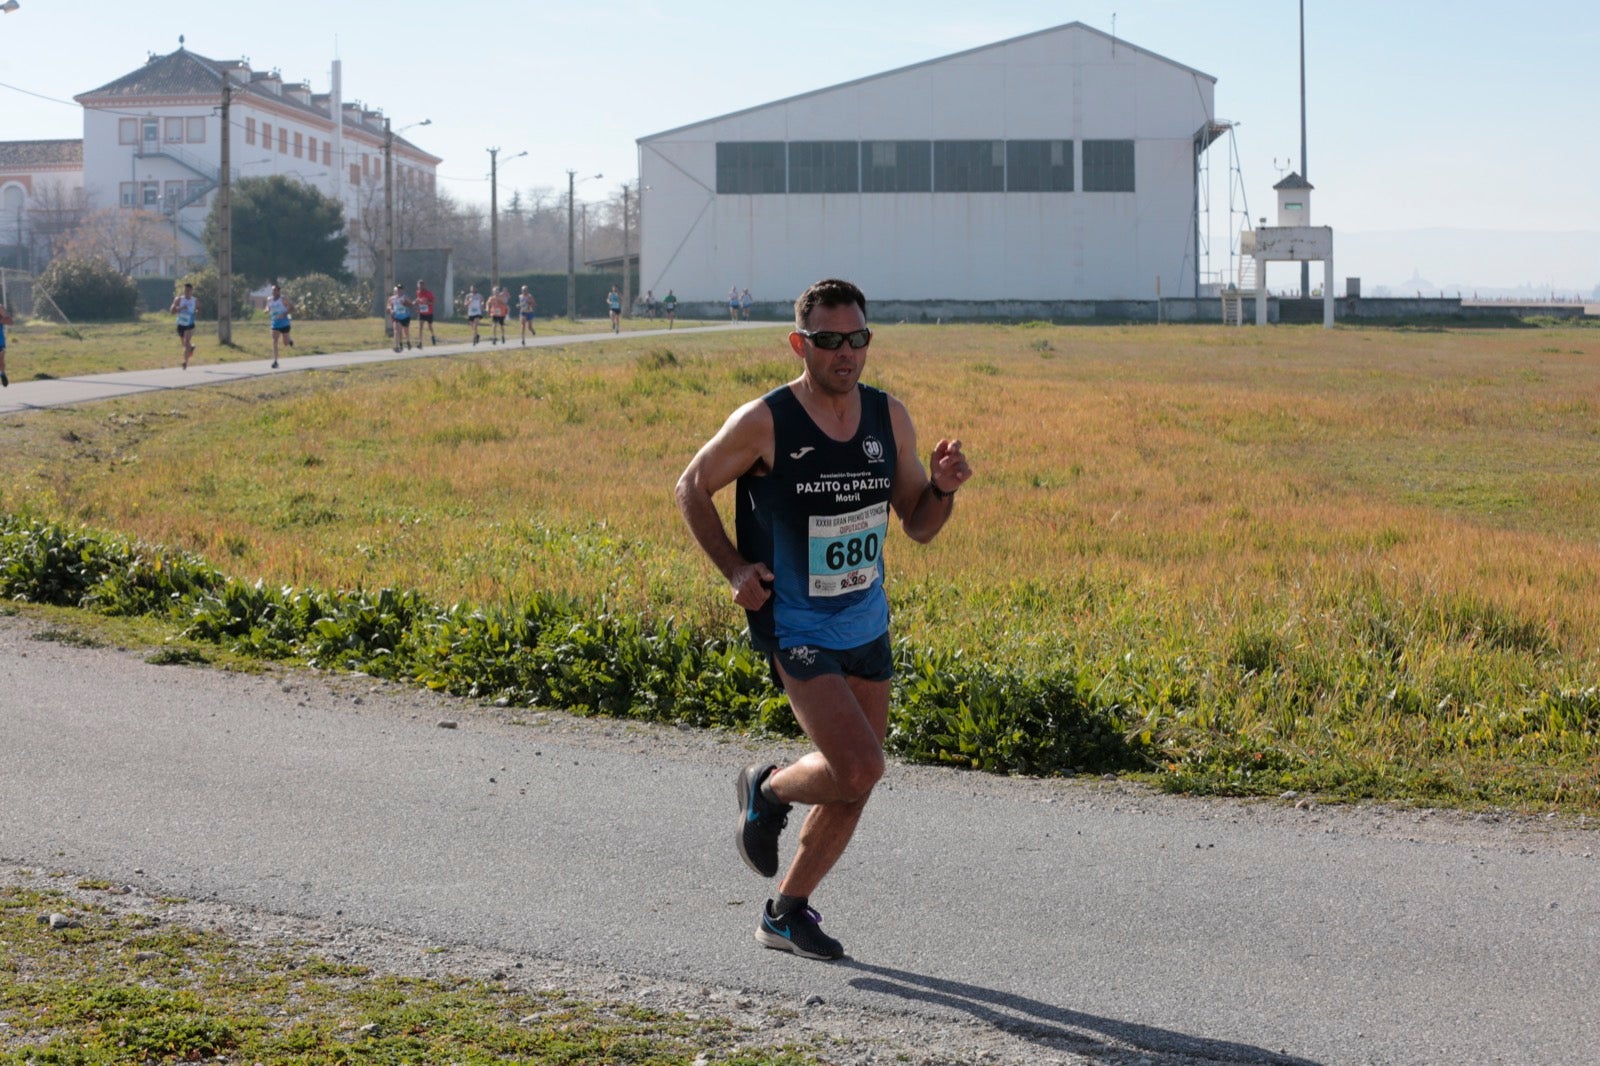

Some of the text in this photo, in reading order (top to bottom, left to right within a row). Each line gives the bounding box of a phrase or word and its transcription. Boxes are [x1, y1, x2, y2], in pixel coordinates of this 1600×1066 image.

[866, 441, 879, 456] 30
[796, 478, 891, 494] PAZITO a PAZITO
[835, 492, 861, 503] Motril
[833, 515, 847, 527] GRAN
[847, 511, 865, 524] PREMIO
[826, 532, 878, 571] 680
